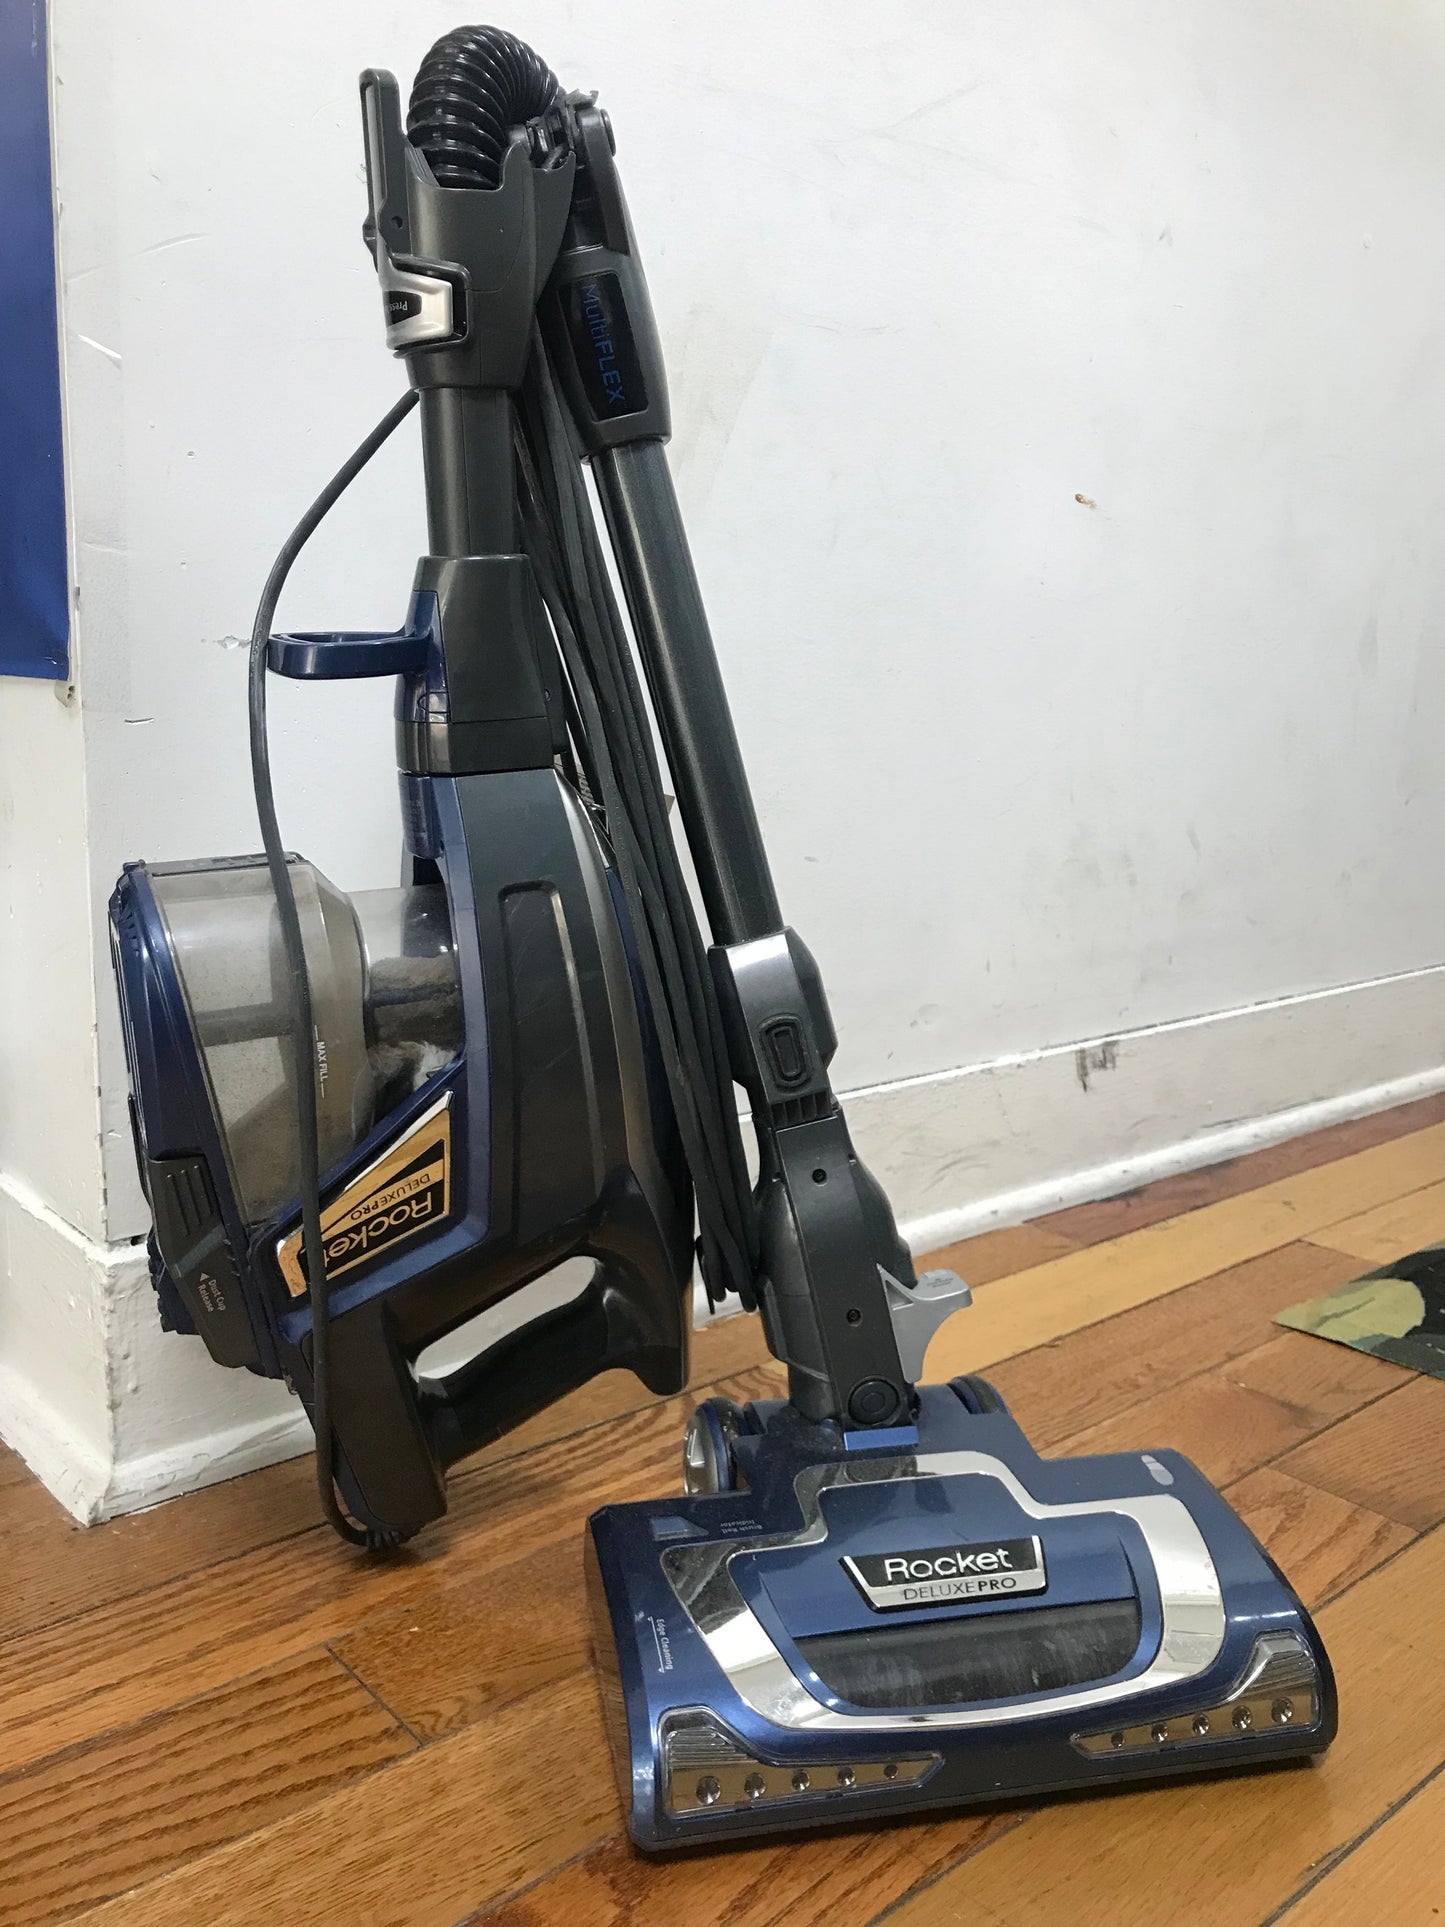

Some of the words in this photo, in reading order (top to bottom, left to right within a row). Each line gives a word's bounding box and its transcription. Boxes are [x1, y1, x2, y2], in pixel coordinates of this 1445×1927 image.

[389, 300, 408, 311] Press
[582, 283, 626, 404] MultiFLEX
[316, 1041, 327, 1062] MAX
[318, 1062, 329, 1082] FILL
[197, 1284, 214, 1312] Release
[208, 1279, 221, 1298] Dust
[216, 1296, 226, 1311] Cup
[884, 1548, 1013, 1582] Rocket
[656, 1618, 667, 1636] Edge
[660, 1636, 674, 1670] Cleaning
